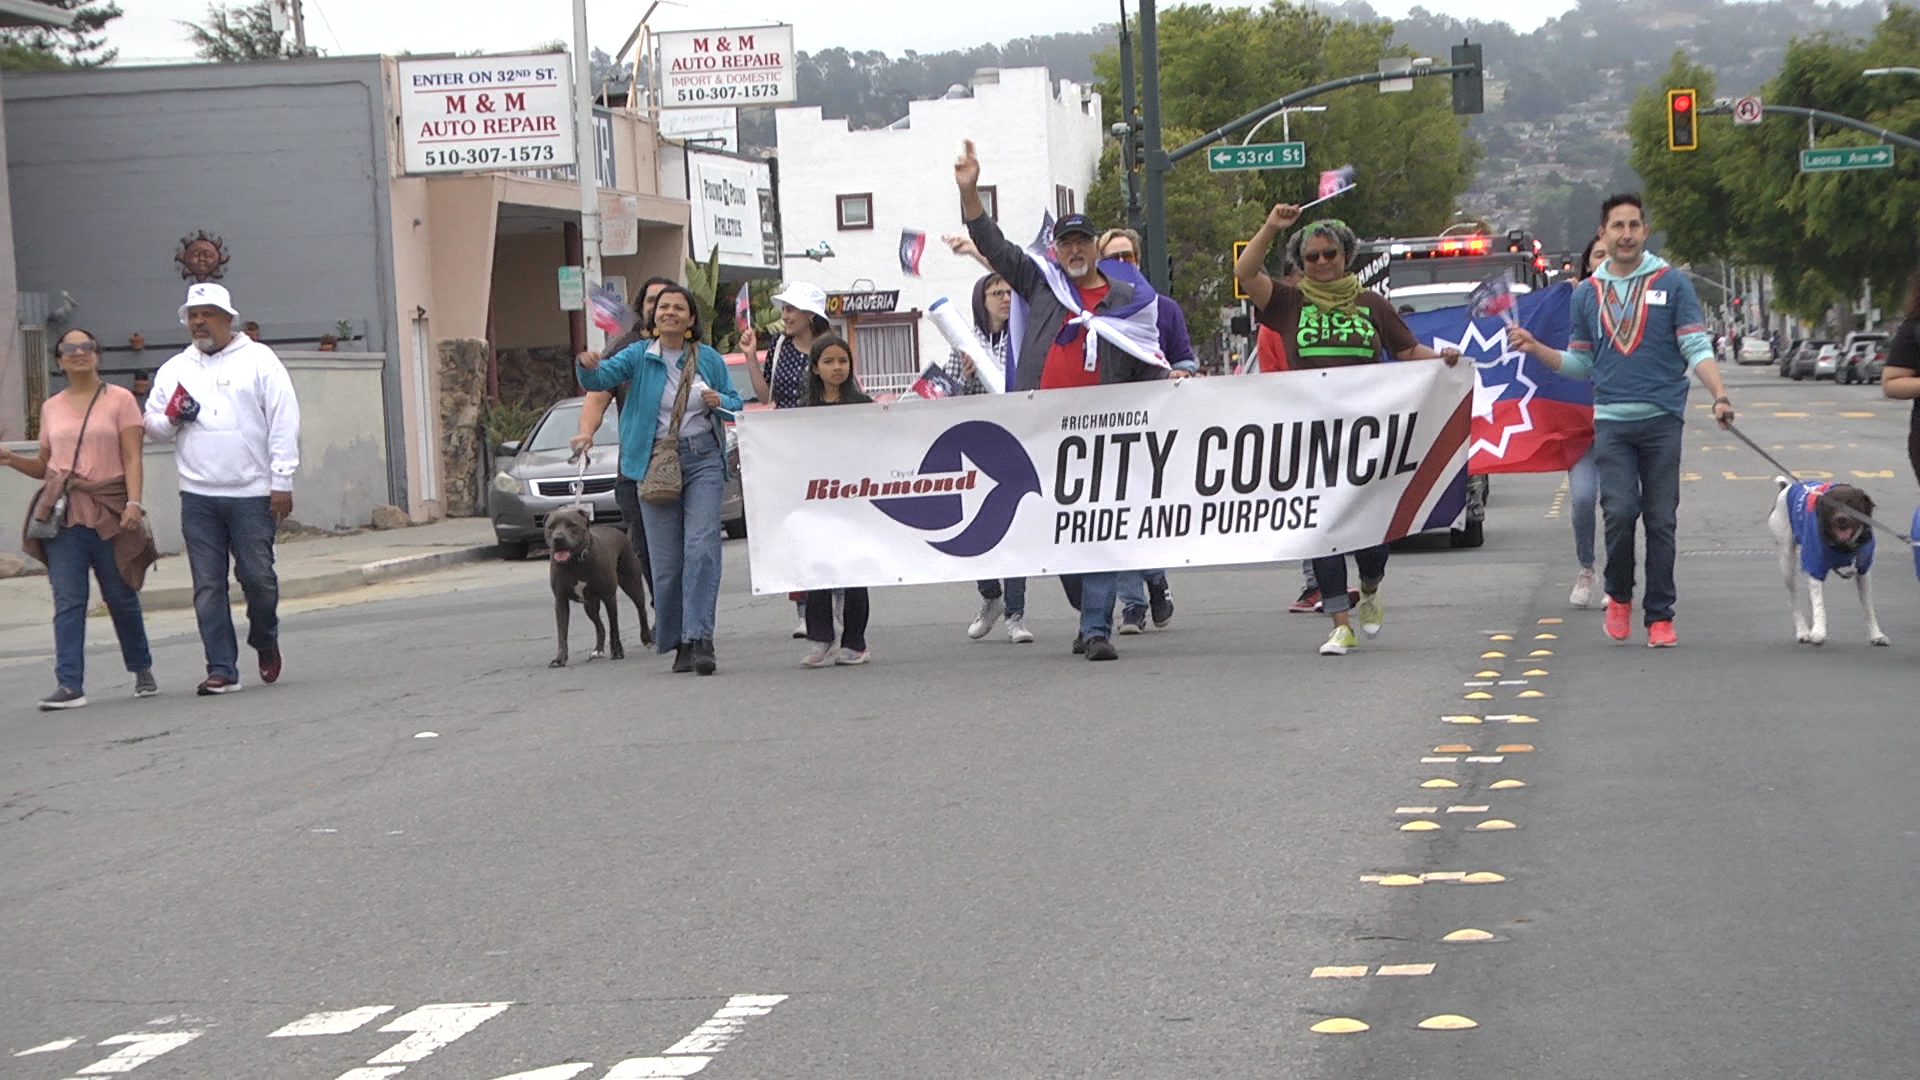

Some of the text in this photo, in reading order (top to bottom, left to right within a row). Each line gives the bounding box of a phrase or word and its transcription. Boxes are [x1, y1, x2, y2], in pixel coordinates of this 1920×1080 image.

[693, 35, 755, 53] M & M
[672, 53, 781, 71] AUTO REPAIR
[413, 68, 557, 86] ENTER ON 32ND ST.
[672, 71, 782, 87] IMPORT & DOMESTIC
[446, 92, 526, 114] M & M
[677, 84, 779, 101] 510-307-1573
[420, 115, 557, 137] AUTO REPAIR
[425, 145, 554, 166] 510-307-1573
[1237, 149, 1300, 164] 33rd St
[1848, 152, 1869, 164] Ave
[842, 291, 895, 312] TAQUERIA
[1061, 410, 1149, 431] #RICHMONDCA
[1054, 410, 1420, 506] CITY COUNCIL
[805, 469, 978, 500] Richmond
[1054, 495, 1320, 544] PRIDE AND PURPOSE
